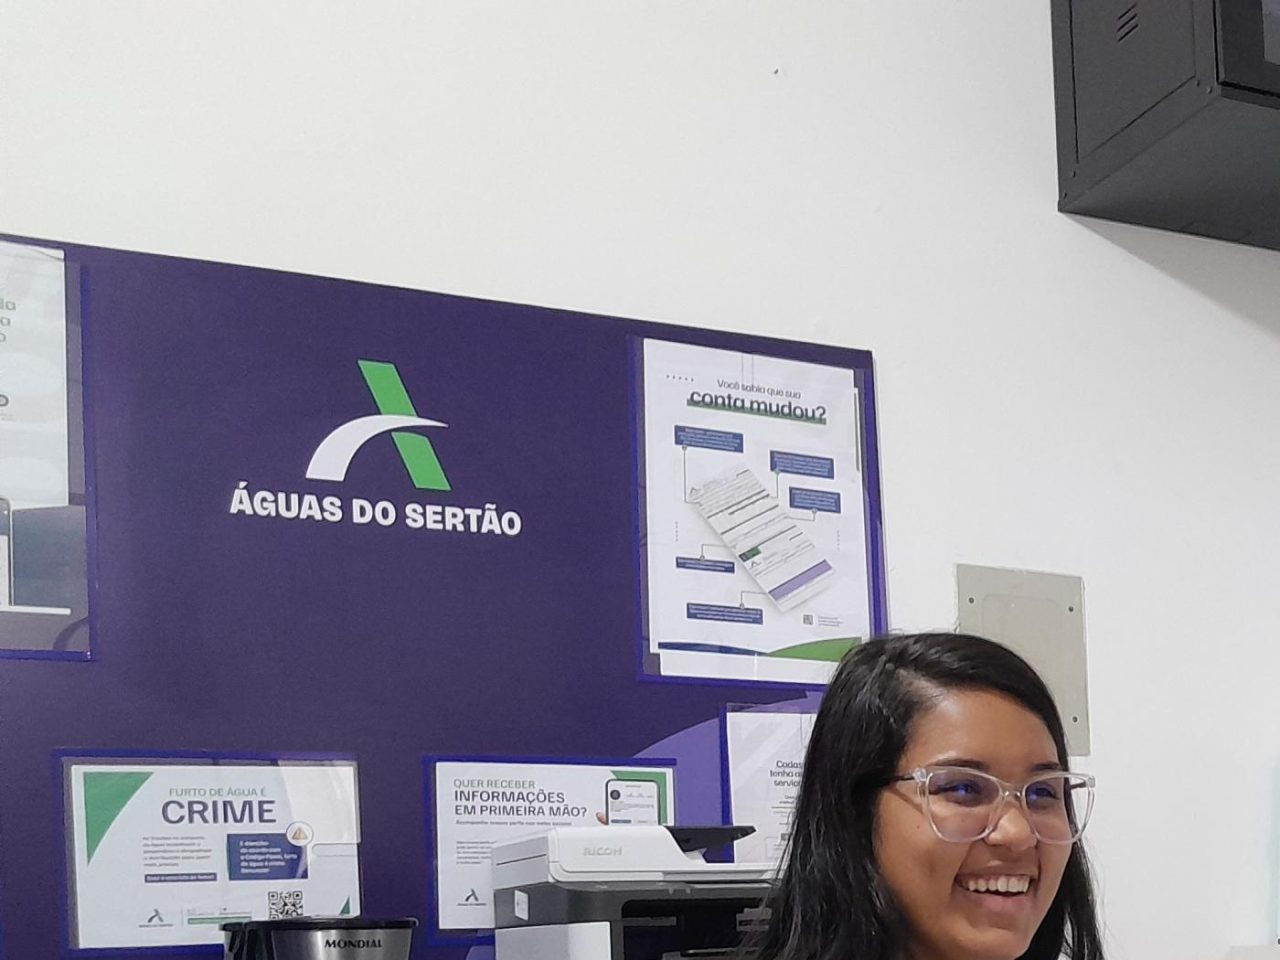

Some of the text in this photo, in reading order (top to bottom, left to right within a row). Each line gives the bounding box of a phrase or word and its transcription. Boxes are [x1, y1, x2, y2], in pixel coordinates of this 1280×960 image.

[716, 378, 802, 400] Você sabia que sua
[689, 390, 827, 422] conta mudou?
[229, 481, 523, 536] ÁGUAS DO SERTÃO
[168, 785, 267, 797] FURTO DE ÁGUA É
[453, 778, 536, 789] QUER RECEBER
[454, 789, 565, 804] INFORMAÇÕES
[161, 799, 277, 824] CRIME
[454, 803, 588, 818] EM PRIMEIRA MÃO?
[324, 938, 383, 949] MONDIAL
